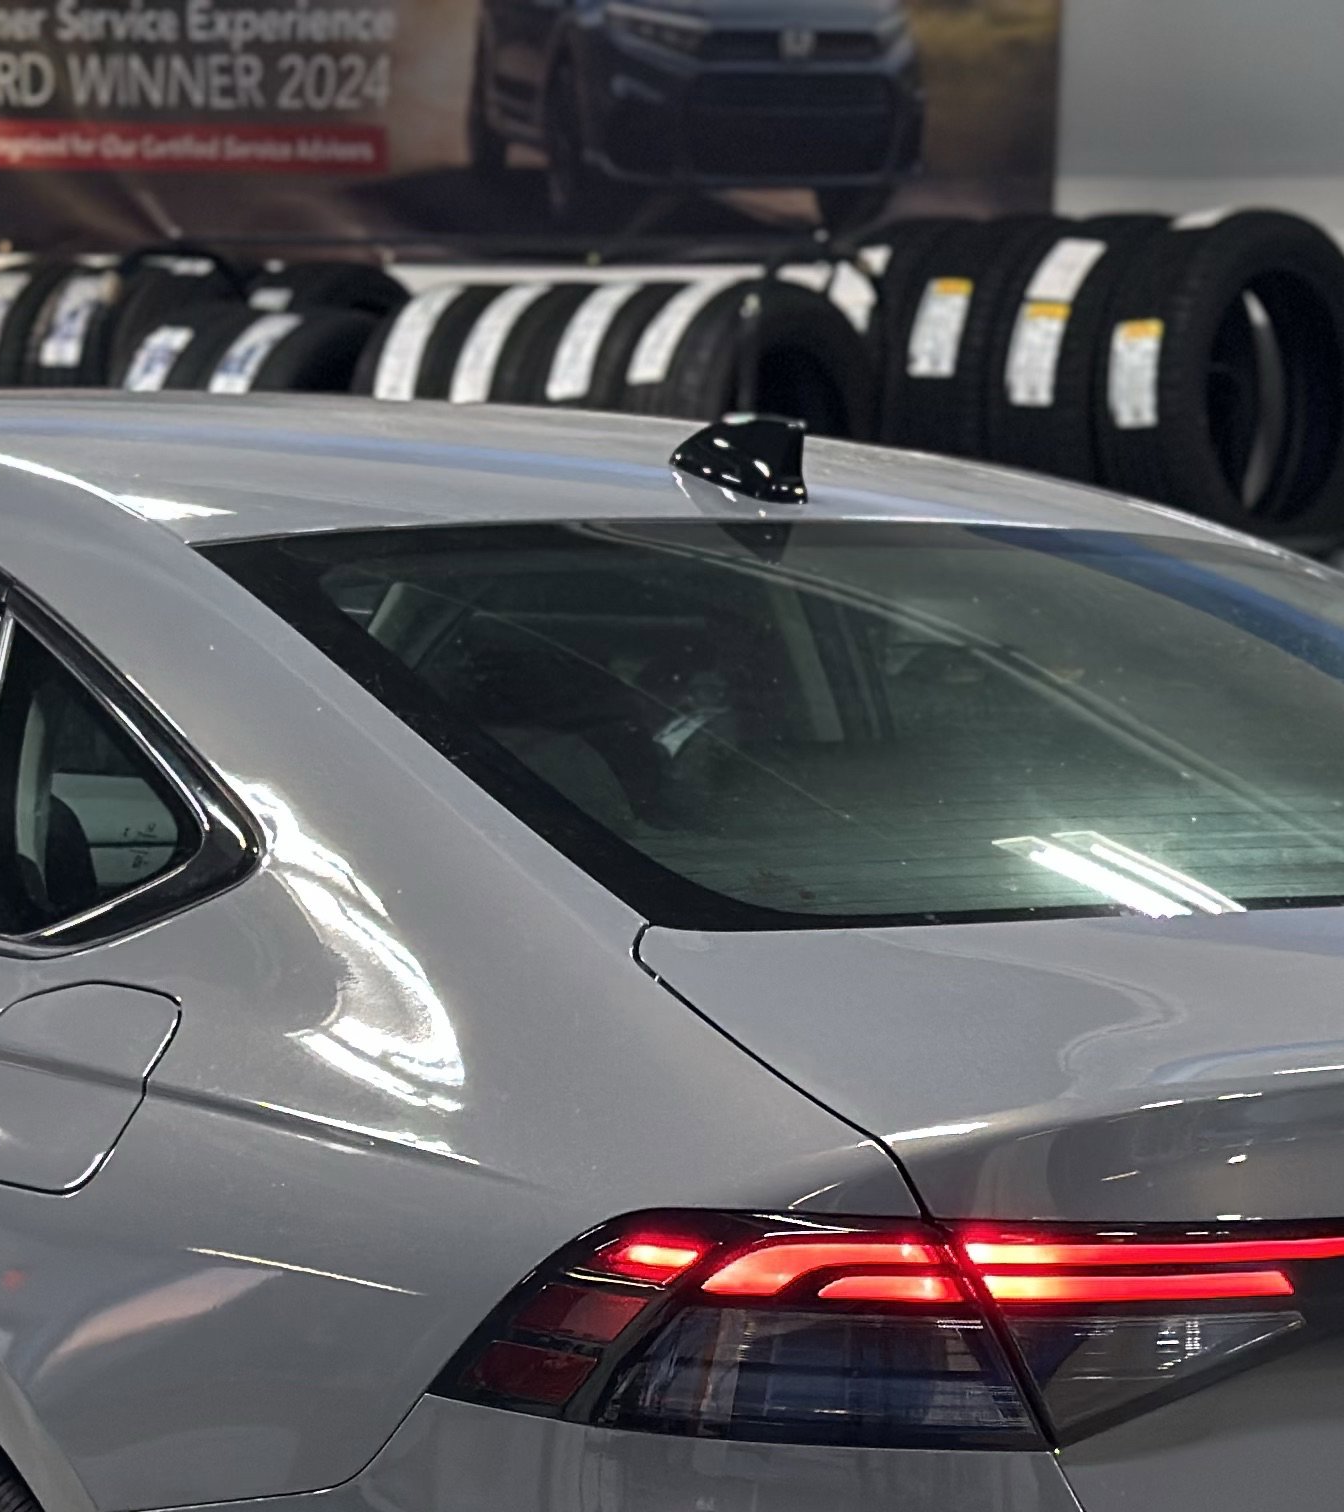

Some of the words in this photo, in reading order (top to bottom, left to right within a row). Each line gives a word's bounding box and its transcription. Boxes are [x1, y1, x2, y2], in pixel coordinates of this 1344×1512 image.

[59, 0, 177, 43] Service
[186, 0, 396, 52] Experience
[67, 53, 264, 109] WINNER
[277, 53, 391, 108] 2024
